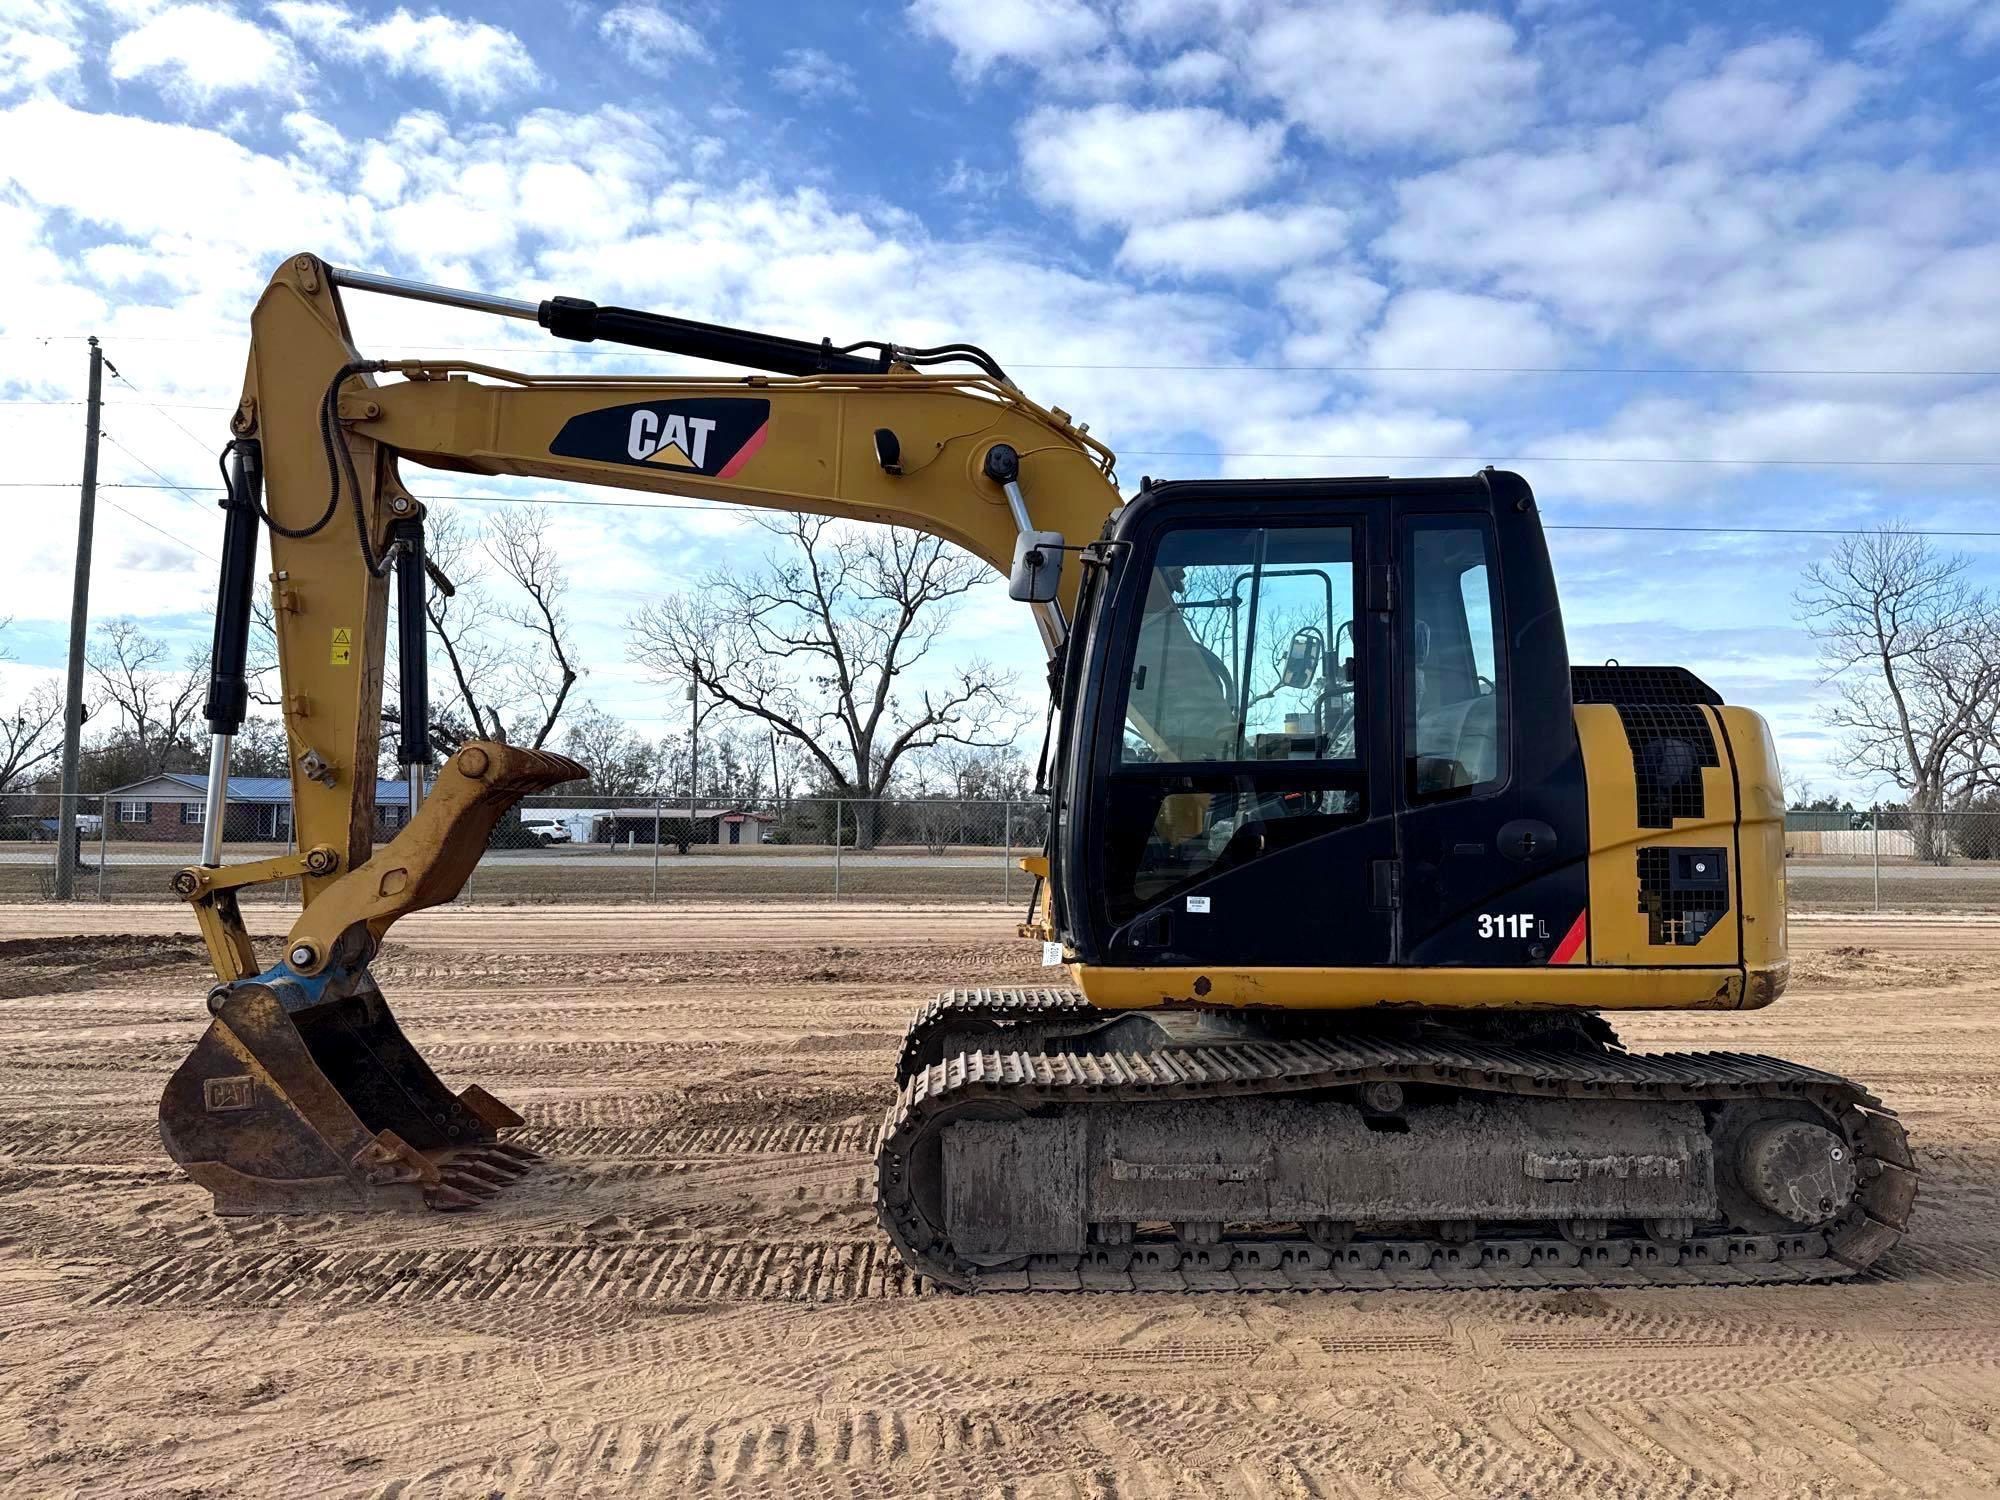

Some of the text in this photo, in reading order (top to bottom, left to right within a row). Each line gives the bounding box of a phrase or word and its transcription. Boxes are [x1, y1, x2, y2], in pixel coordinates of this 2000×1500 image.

[627, 409, 716, 469] CAT
[1477, 913, 1550, 939] 311F L
[209, 1082, 250, 1108] CAT
